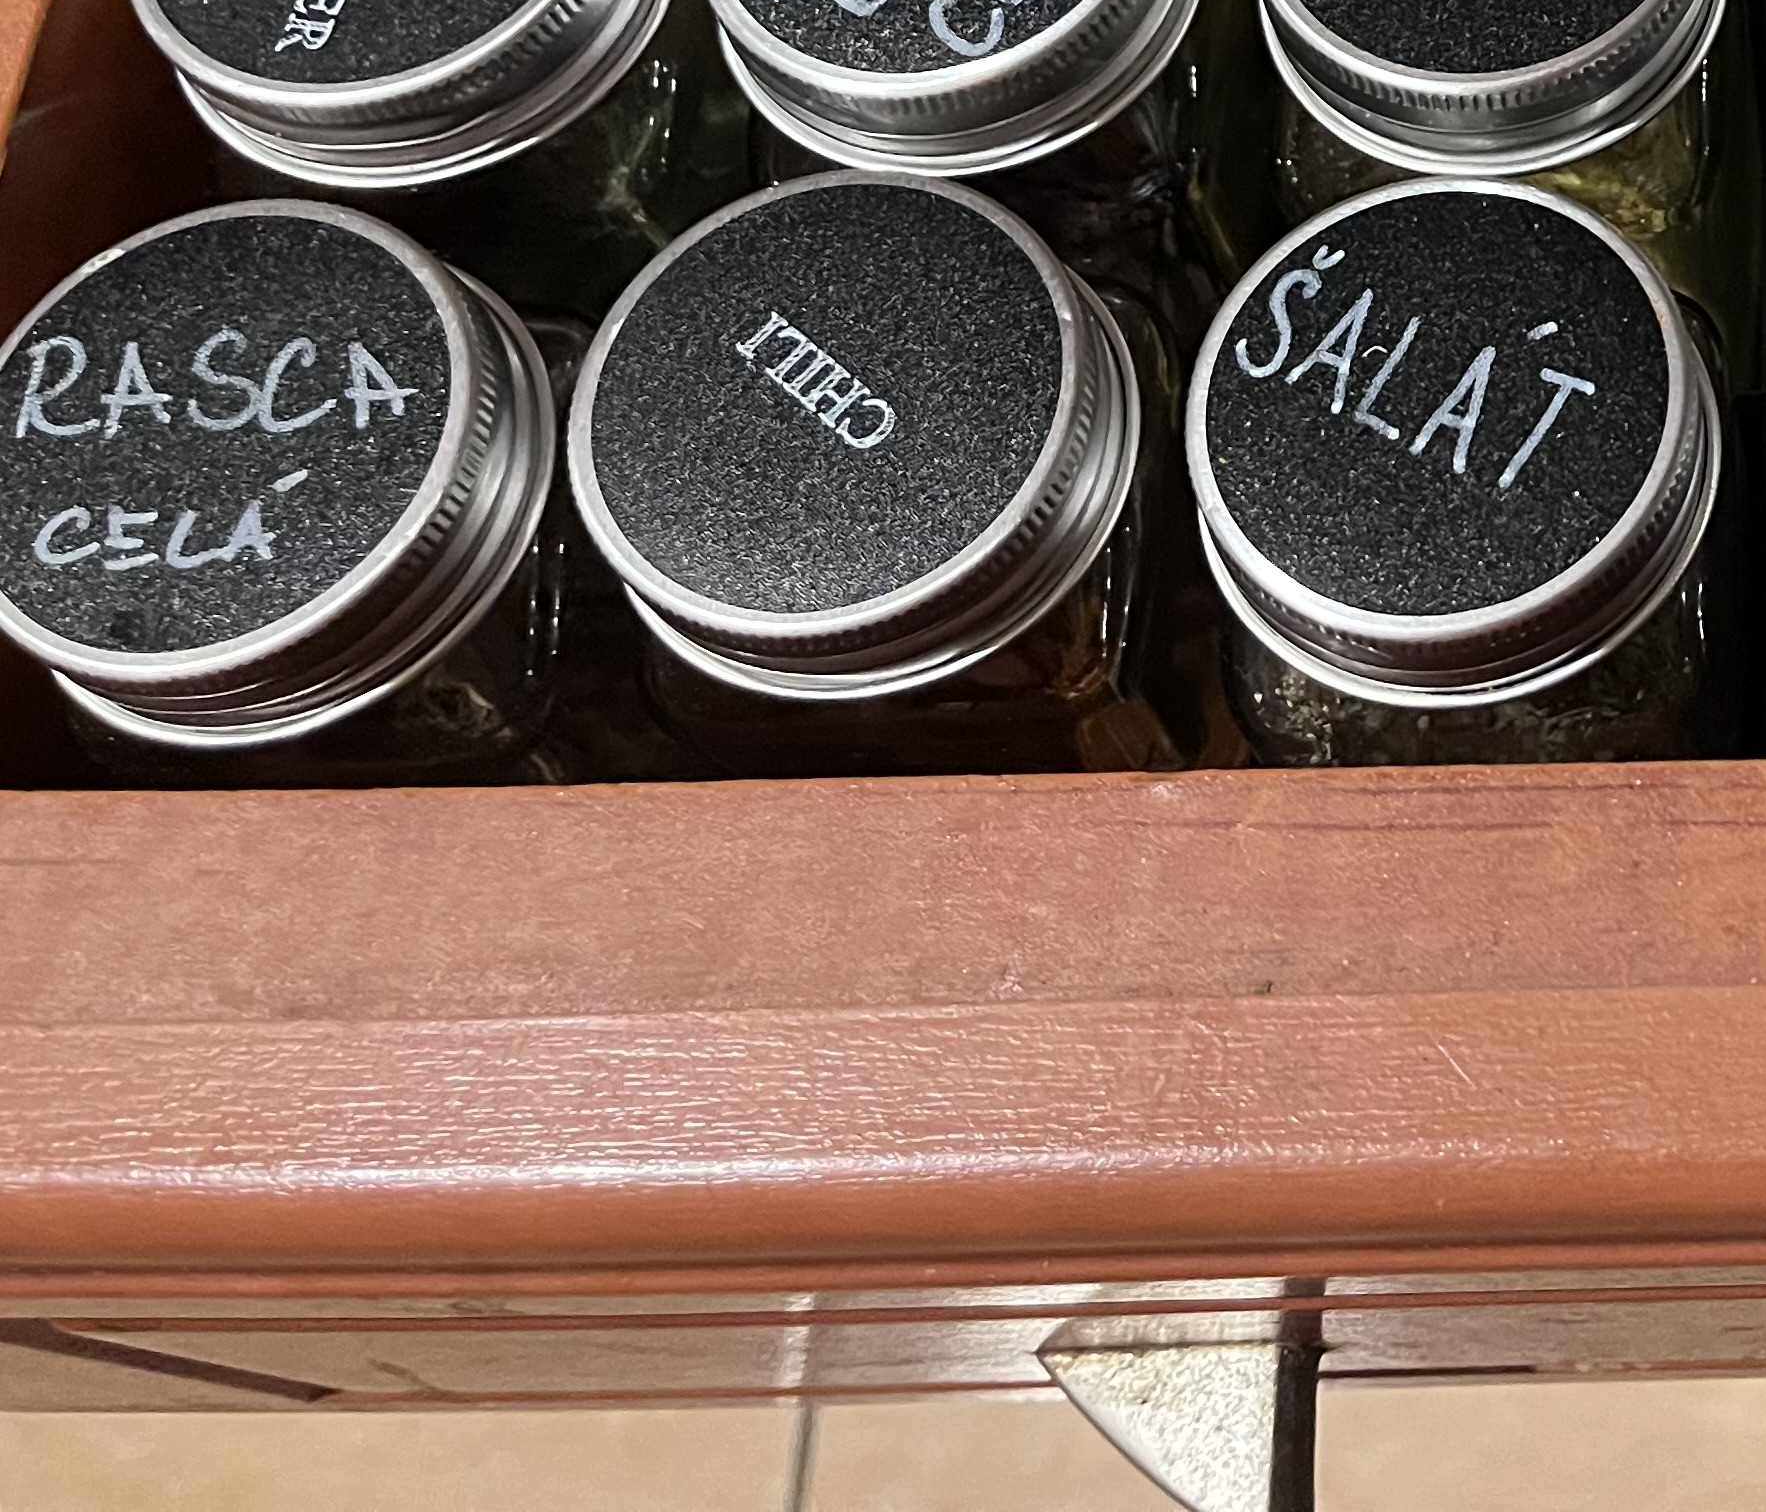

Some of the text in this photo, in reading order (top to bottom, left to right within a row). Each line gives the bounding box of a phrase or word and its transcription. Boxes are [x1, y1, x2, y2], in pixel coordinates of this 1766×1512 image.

[14, 327, 419, 440] RASCA
[734, 309, 898, 451] CHILI
[1234, 243, 1595, 489] ŠALÁT
[32, 468, 310, 572] CELÁ
